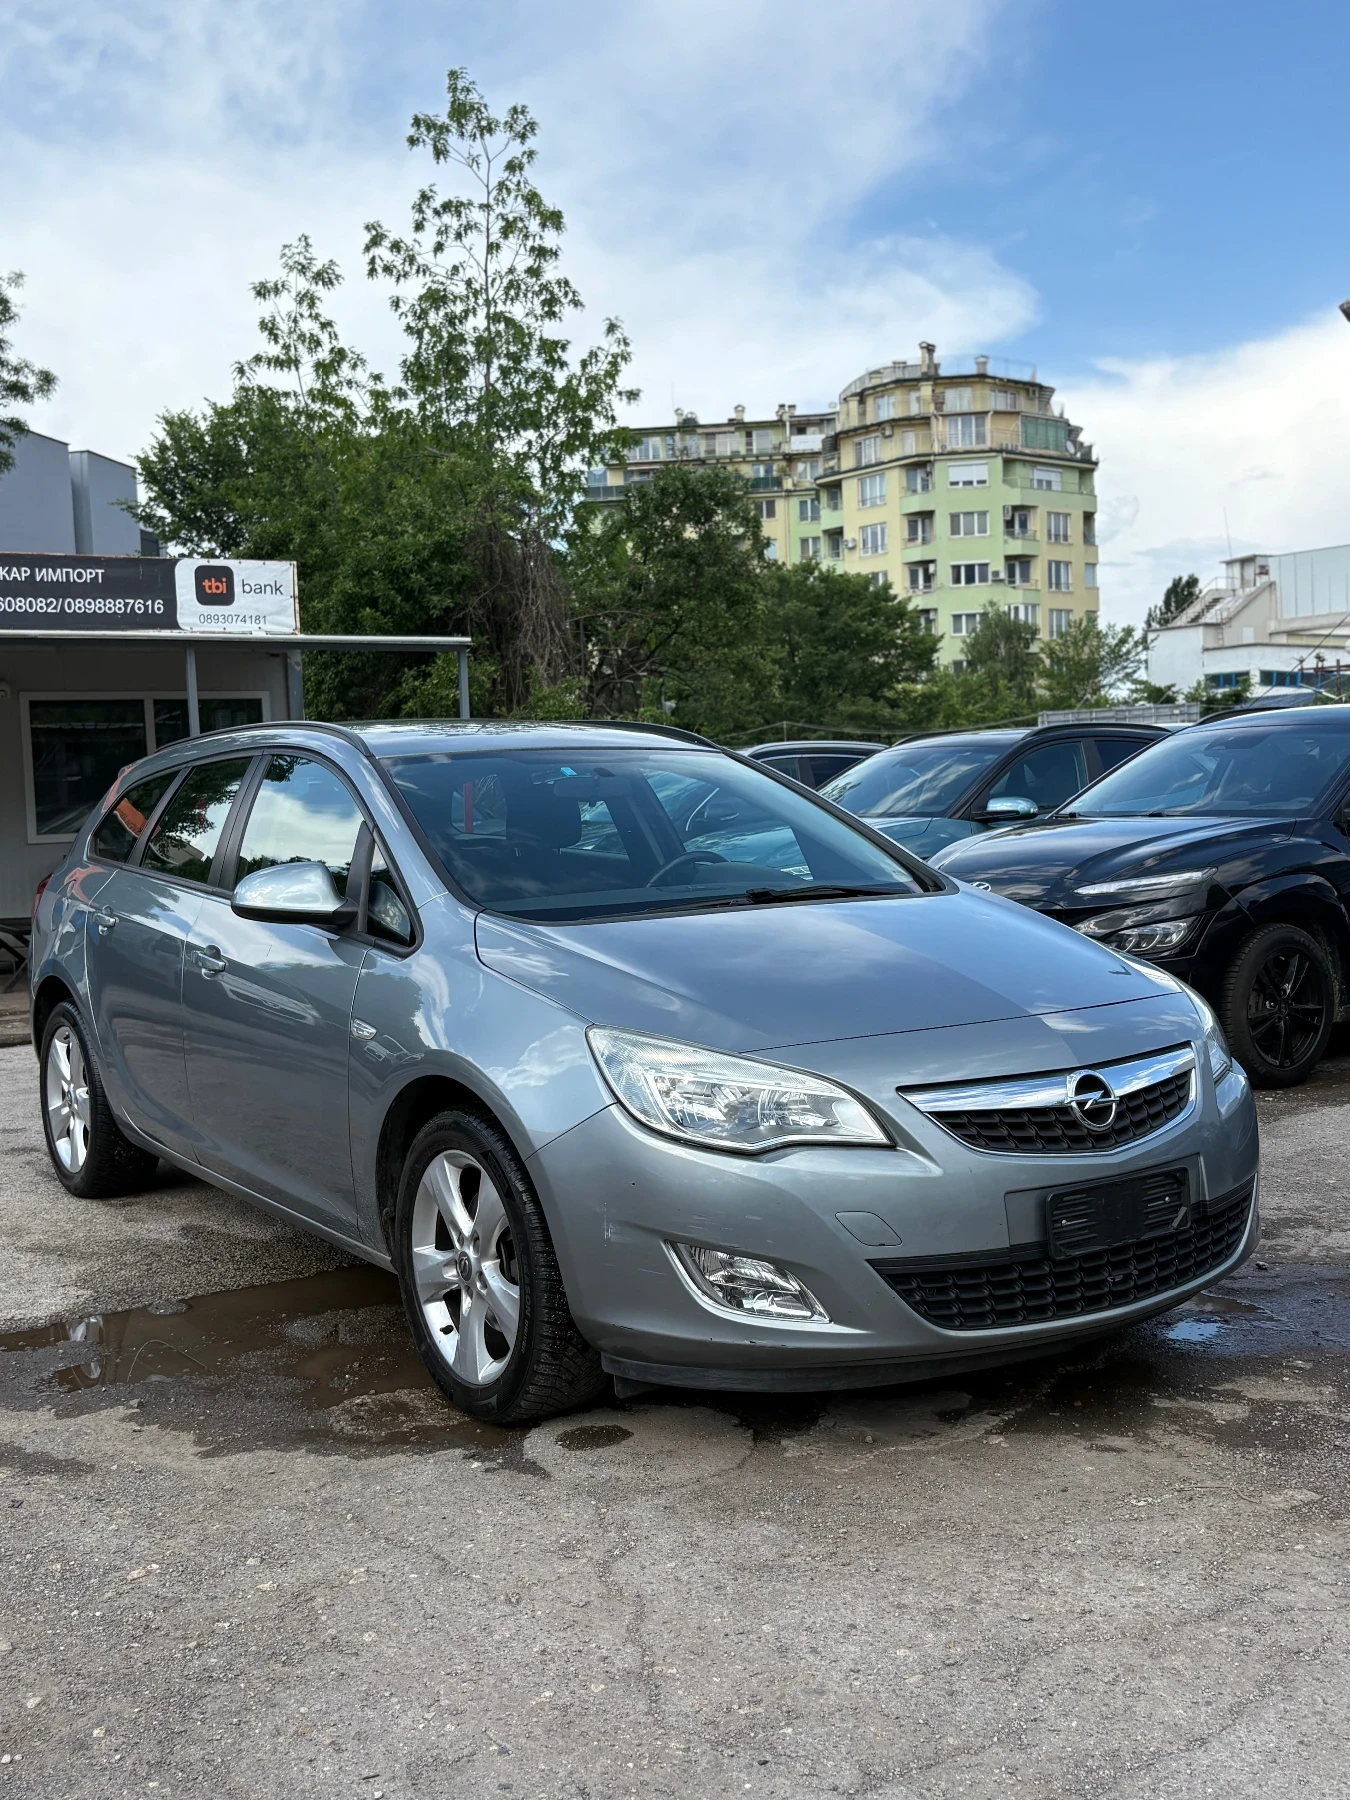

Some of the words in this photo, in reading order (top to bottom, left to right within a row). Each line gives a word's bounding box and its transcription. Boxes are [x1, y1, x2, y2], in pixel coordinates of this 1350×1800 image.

[0, 566, 31, 582] КАР
[35, 567, 105, 583] ИМПОРТ
[202, 577, 228, 594] tbi
[241, 578, 284, 596] bank
[199, 613, 268, 626] 0893074181
